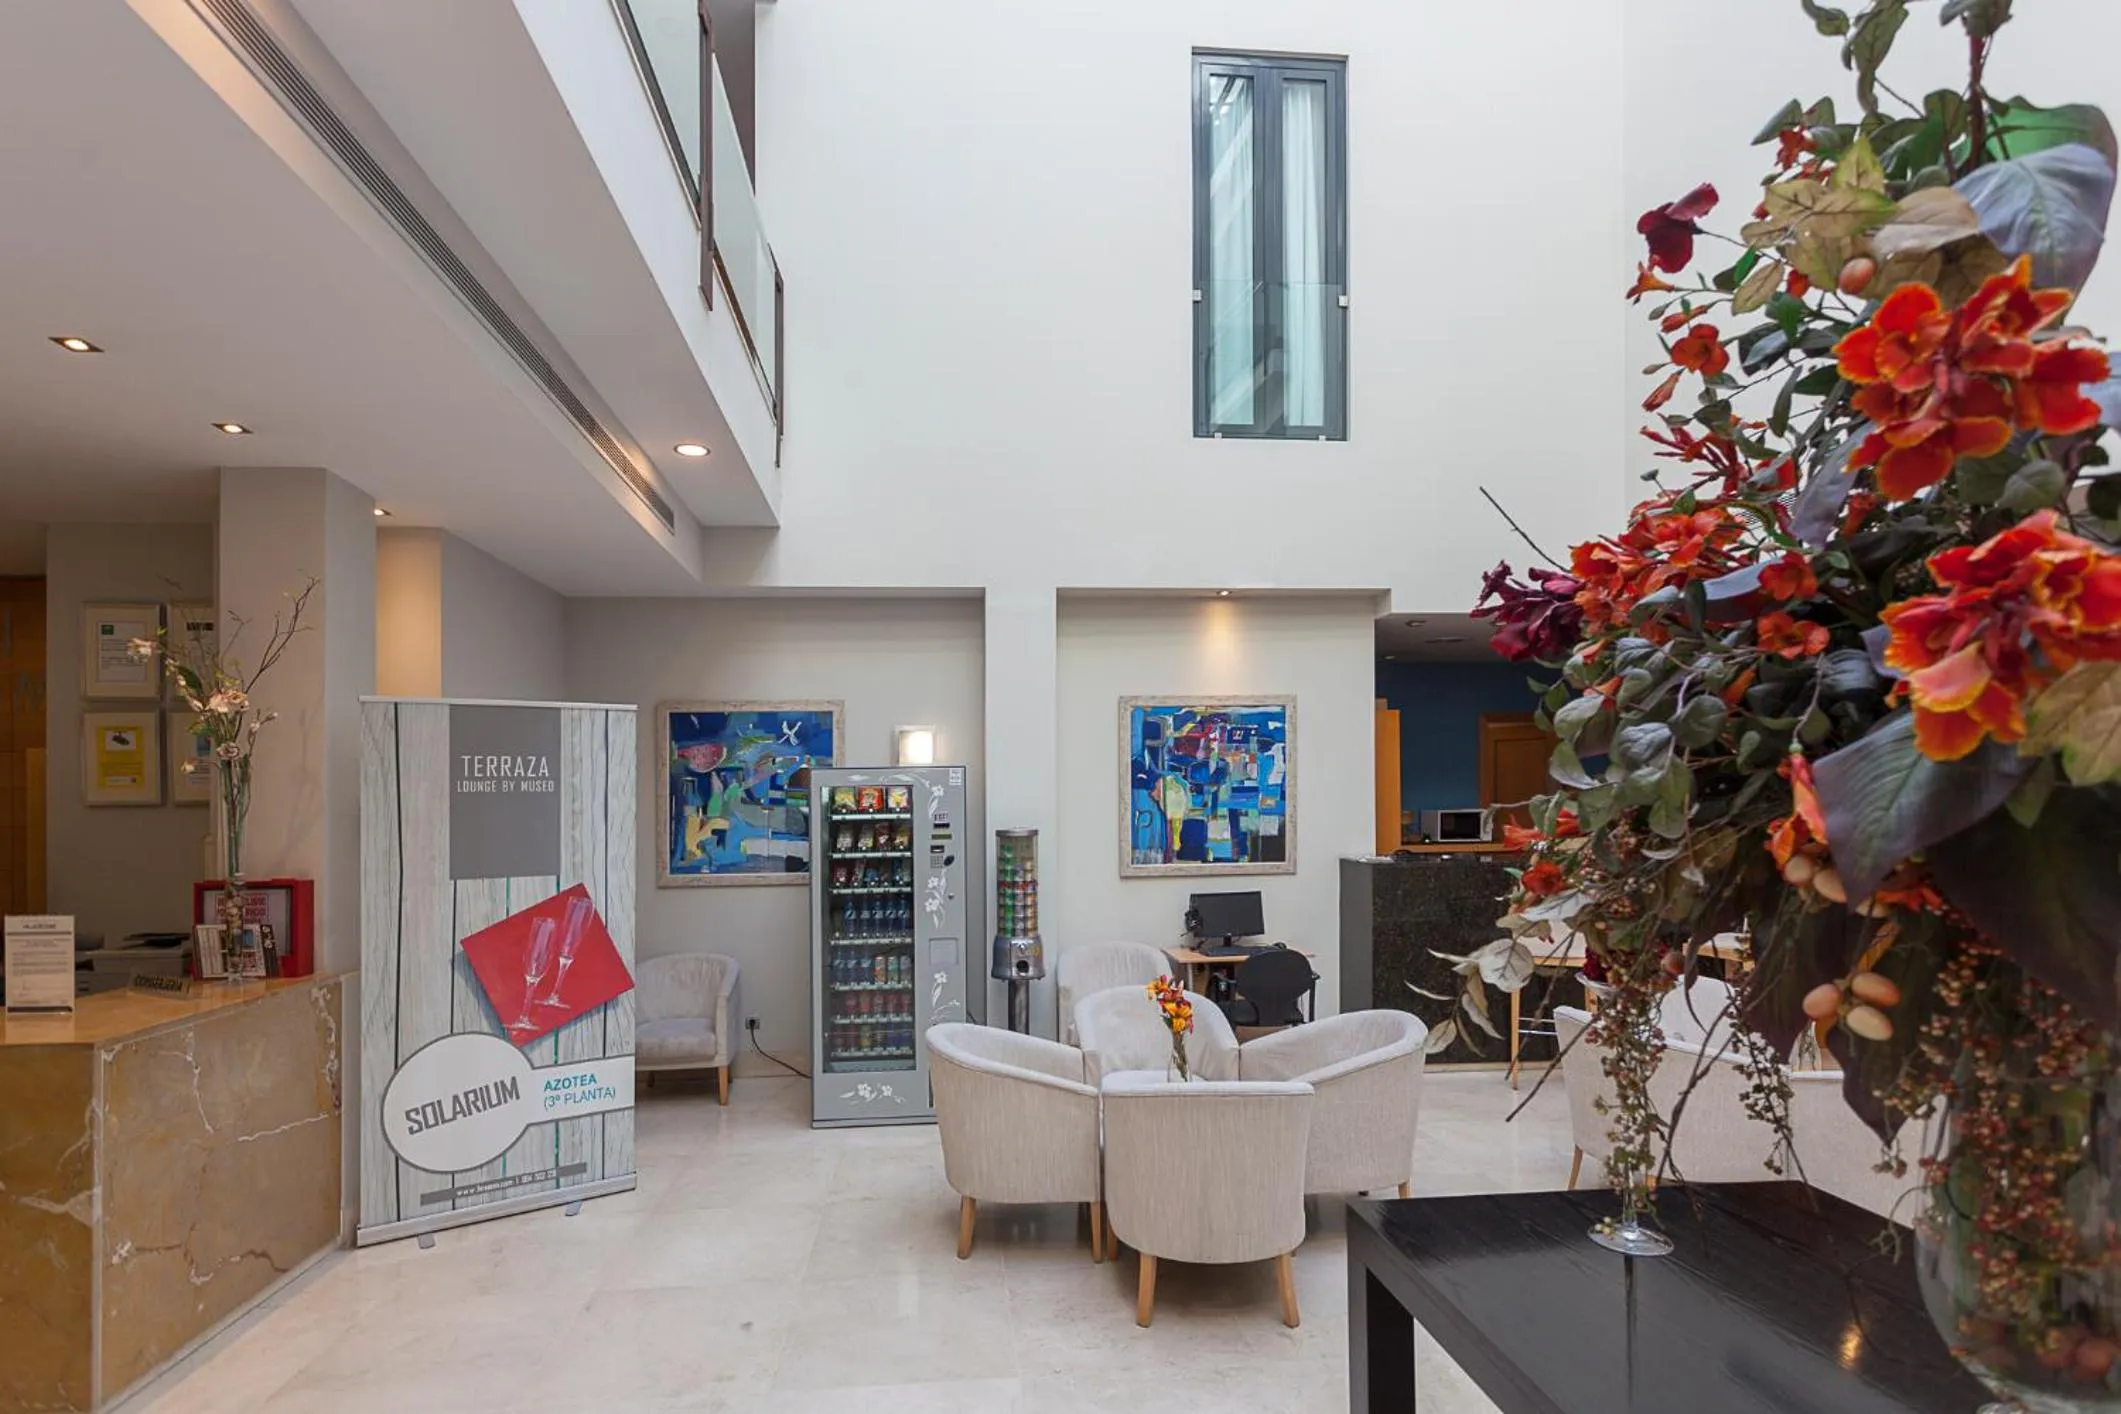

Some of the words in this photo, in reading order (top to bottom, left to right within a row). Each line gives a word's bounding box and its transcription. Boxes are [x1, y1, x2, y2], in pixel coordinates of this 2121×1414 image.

[461, 755, 549, 777] TERRAZA
[457, 780, 497, 793] LOUNGE
[502, 780, 516, 793] BY
[520, 780, 555, 793] MUSEO
[543, 1073, 598, 1092] AZOTEA
[404, 1076, 520, 1135] SOLARIUM
[563, 1087, 616, 1105] PLANTA)
